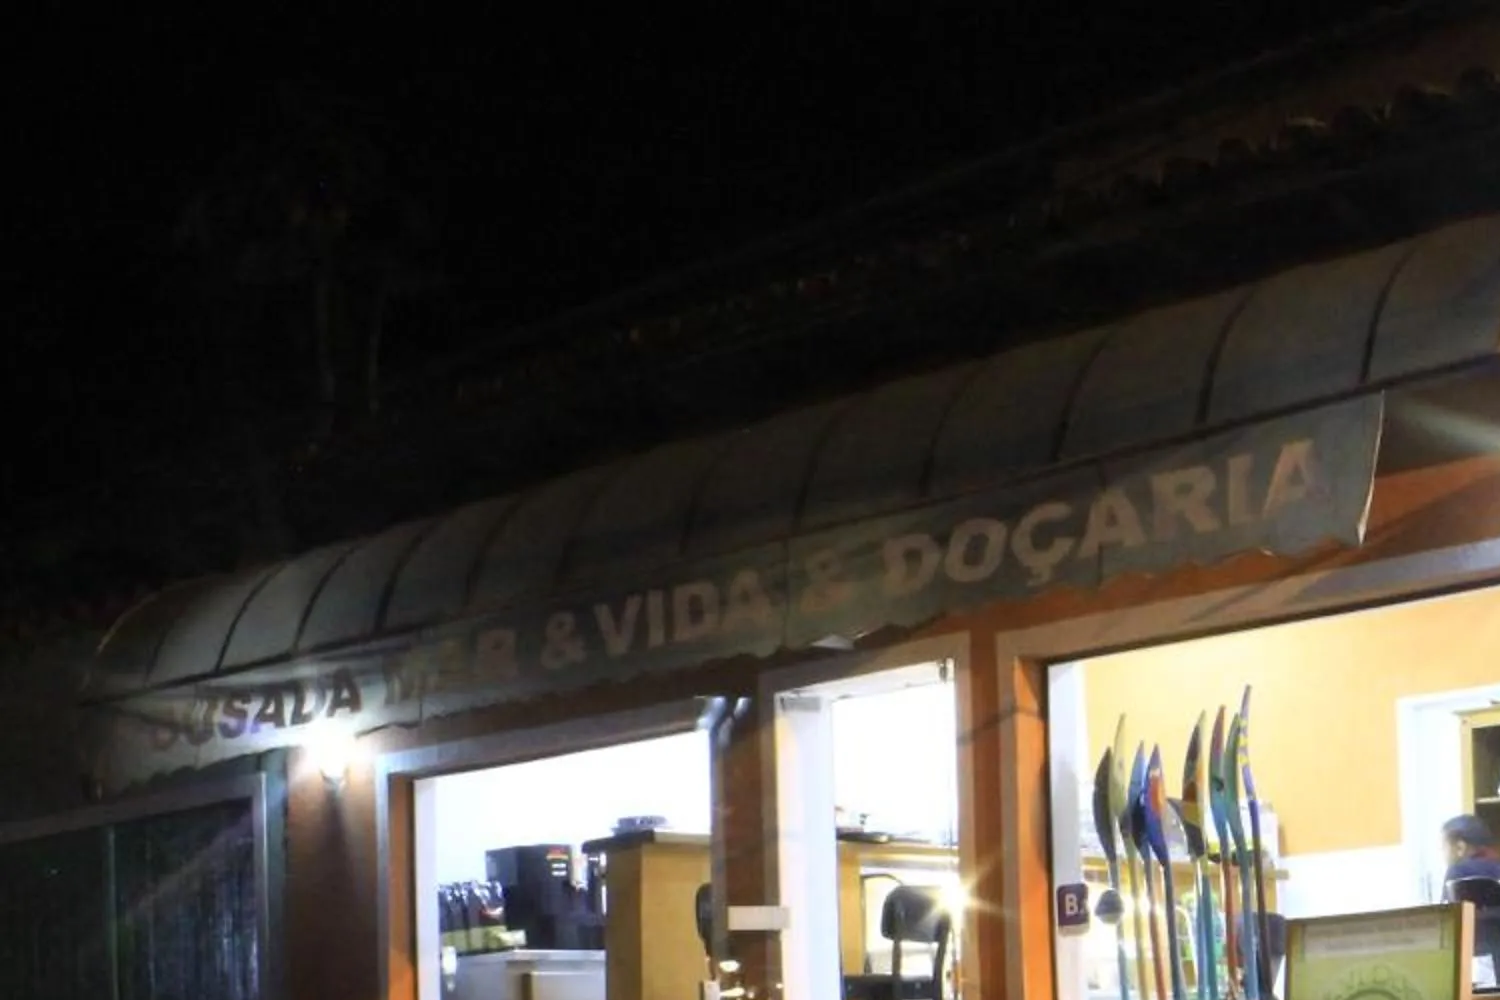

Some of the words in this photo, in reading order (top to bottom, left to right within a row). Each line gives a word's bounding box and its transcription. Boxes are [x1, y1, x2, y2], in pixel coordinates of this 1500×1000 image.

[541, 611, 588, 669] &
[593, 567, 775, 658] VIDA
[882, 439, 1317, 597] DOÇARIA
